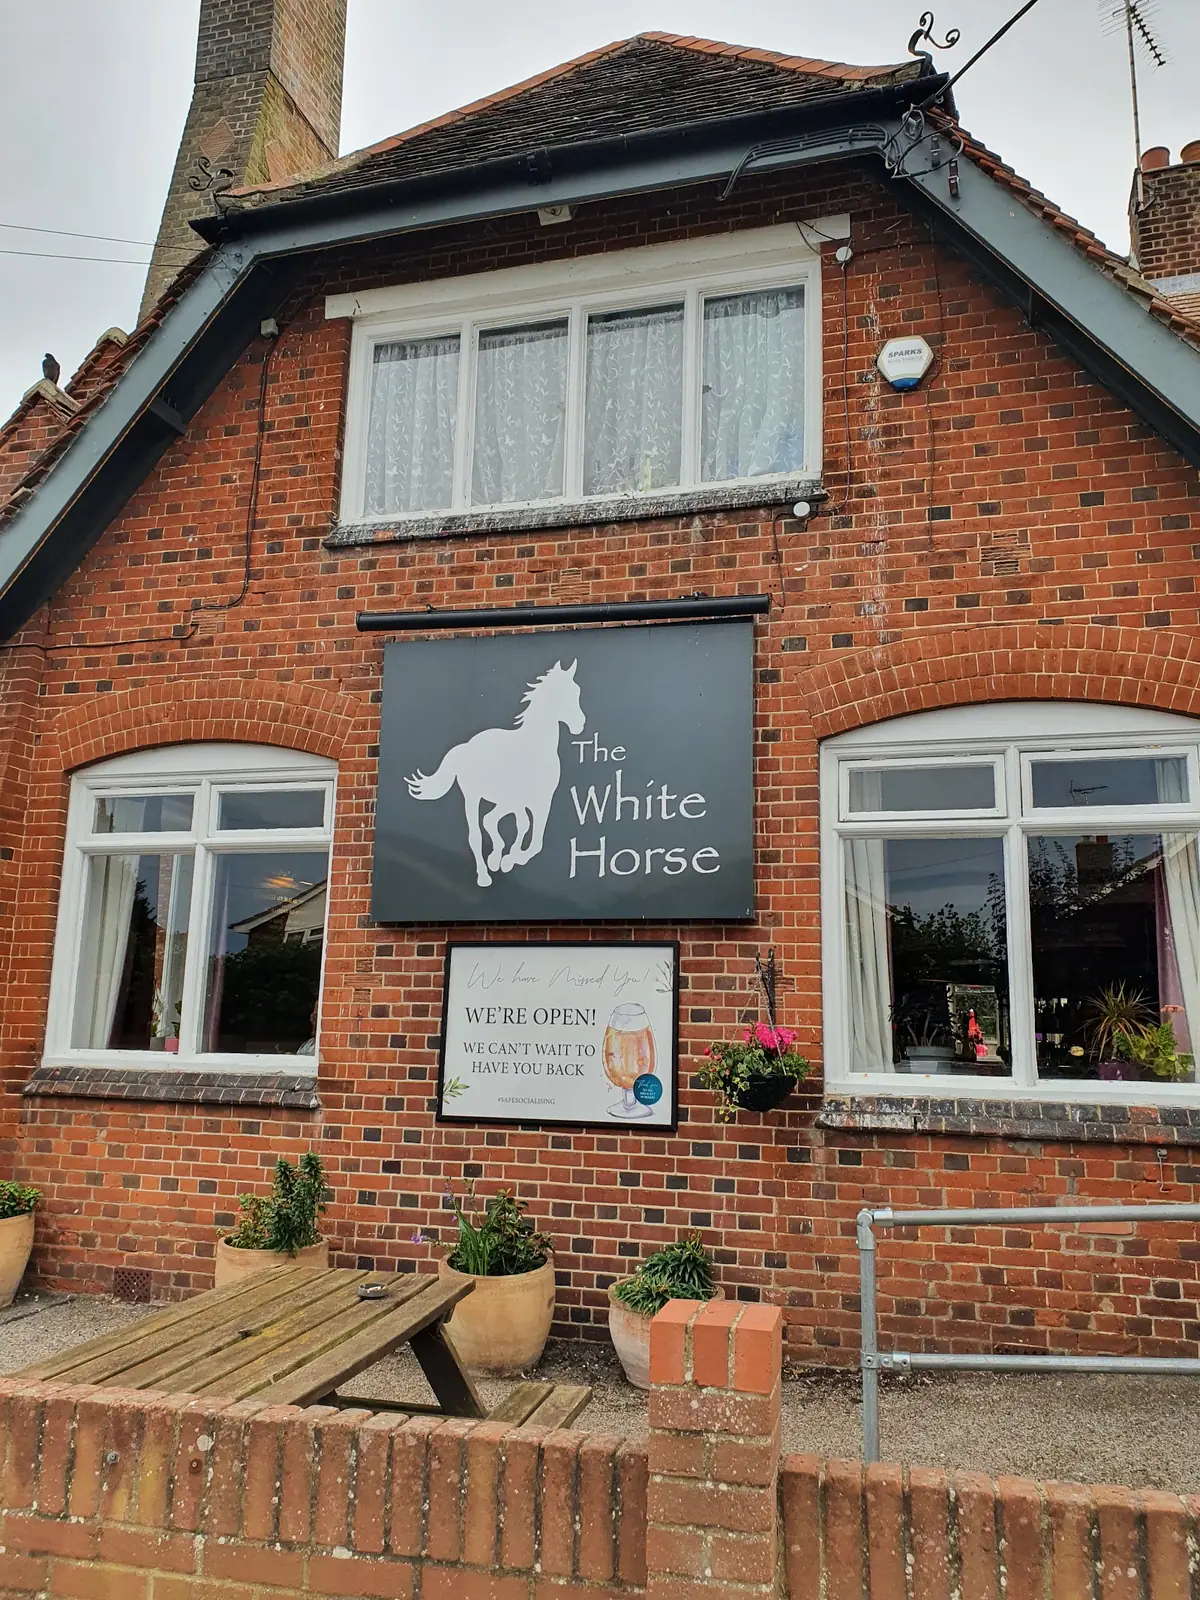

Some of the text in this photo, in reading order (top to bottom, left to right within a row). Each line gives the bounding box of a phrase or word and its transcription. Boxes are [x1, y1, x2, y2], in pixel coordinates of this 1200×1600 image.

[888, 348, 922, 358] SPARKS
[571, 732, 627, 764] The
[569, 768, 708, 826] White
[568, 835, 721, 879] Horse
[467, 961, 651, 997] We have Missed You!
[464, 1006, 597, 1027] WE'RE OPEN!
[463, 1041, 596, 1058] WE CAN'T WAIT TO
[471, 1061, 585, 1077] HAVE YOU BACK
[497, 1097, 556, 1105] #SAFESOCIALISING
